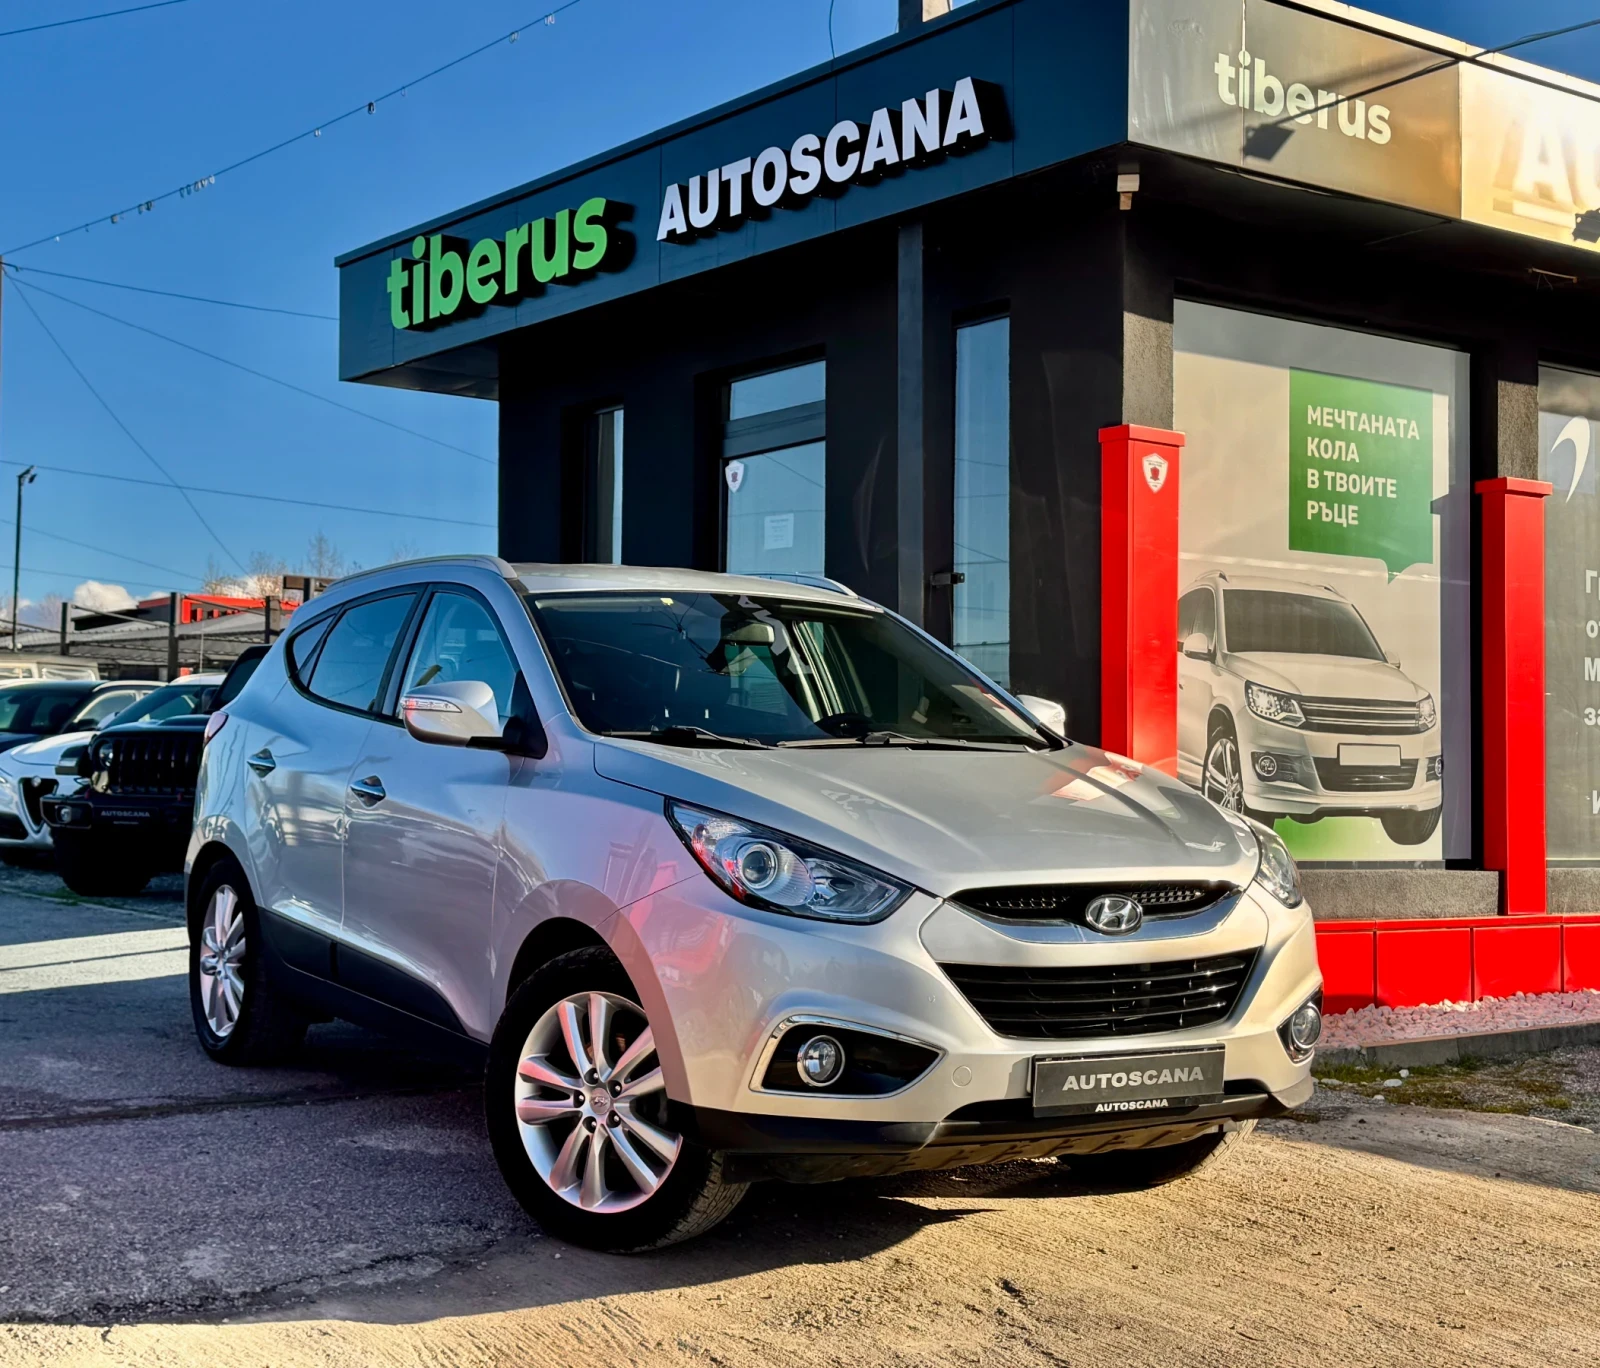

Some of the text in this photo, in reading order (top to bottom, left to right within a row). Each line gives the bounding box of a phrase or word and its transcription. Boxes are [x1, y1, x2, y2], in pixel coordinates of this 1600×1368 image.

[1213, 49, 1393, 146] tiberus
[656, 76, 985, 241] AUTOSCANA
[386, 197, 609, 330] tiberus
[1307, 404, 1420, 440] МЕЧТАНАТА
[1307, 436, 1360, 463] КОЛА
[1307, 468, 1397, 498] В ТВОИТЕ
[1307, 500, 1359, 527] РЪЦЕ
[1585, 569, 1600, 601] Г
[1062, 1066, 1204, 1091] AUTOSCANA
[1095, 1098, 1169, 1113] AUTOSCANA
